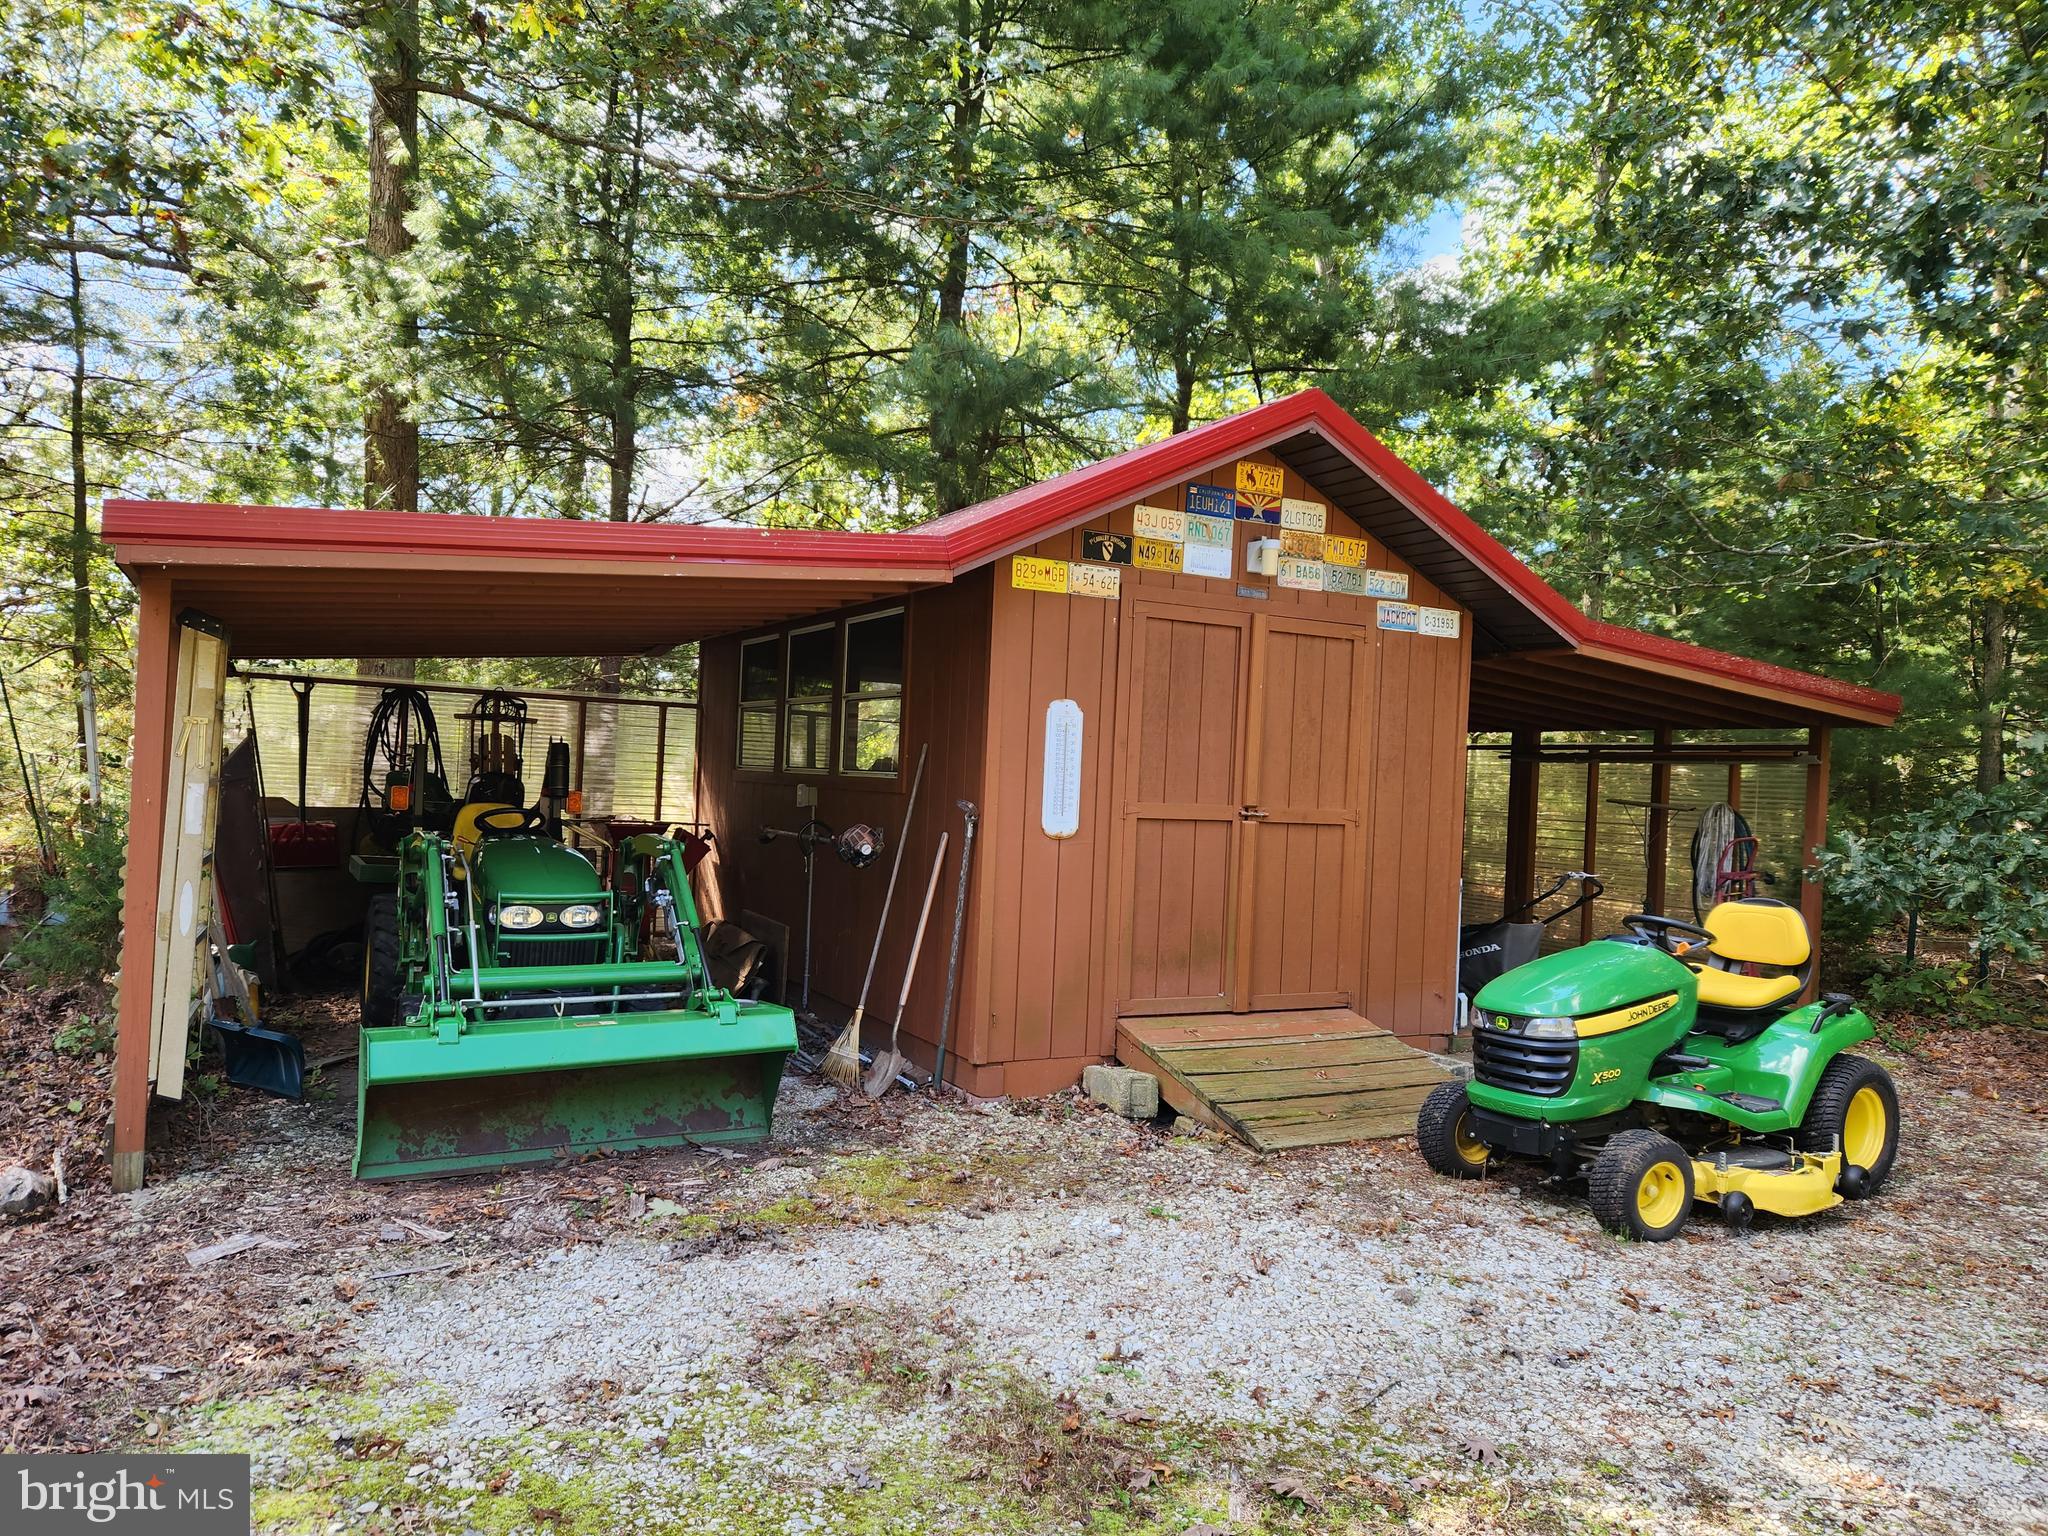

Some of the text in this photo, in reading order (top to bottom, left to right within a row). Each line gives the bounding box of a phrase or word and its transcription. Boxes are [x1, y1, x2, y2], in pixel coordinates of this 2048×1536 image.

[1258, 471, 1281, 489] 7247
[1189, 494, 1232, 515] 1EUH161
[1136, 511, 1182, 531] 43J 059
[1284, 509, 1324, 529] 2LGT305
[1211, 525, 1231, 542] 067
[1138, 544, 1157, 560] N49
[1163, 547, 1181, 565] 146
[1326, 538, 1367, 559] FWD 673
[1015, 562, 1066, 583] 829 MGB
[1082, 572, 1119, 591] 54-62F
[1295, 565, 1321, 580] BA58
[1381, 608, 1417, 626] JACKPOT
[1628, 1000, 1670, 1021] JOHN DEERE
[1591, 1068, 1622, 1085] X500
